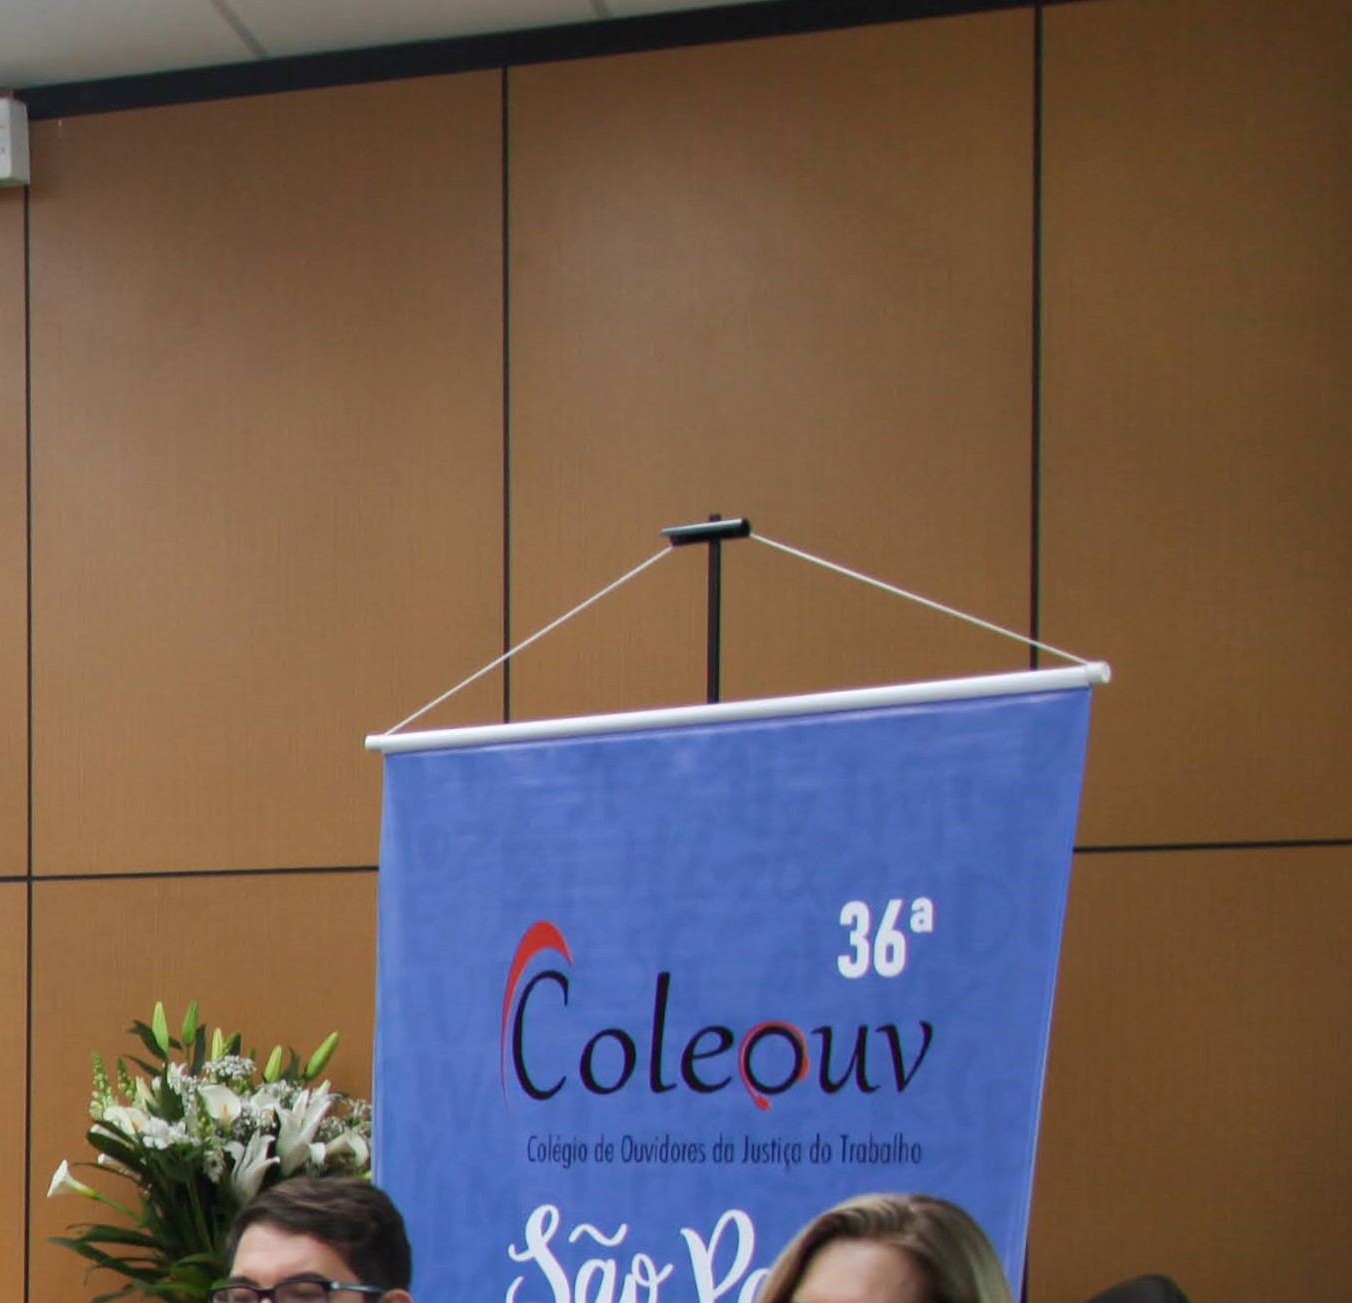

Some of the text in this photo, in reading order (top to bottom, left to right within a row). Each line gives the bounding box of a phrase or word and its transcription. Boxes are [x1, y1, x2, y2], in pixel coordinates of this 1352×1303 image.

[837, 897, 933, 978] 36ª
[509, 964, 934, 1104] Coleouv
[527, 1133, 922, 1171] Colégio de Ouvidores da Justiça do Trabalho
